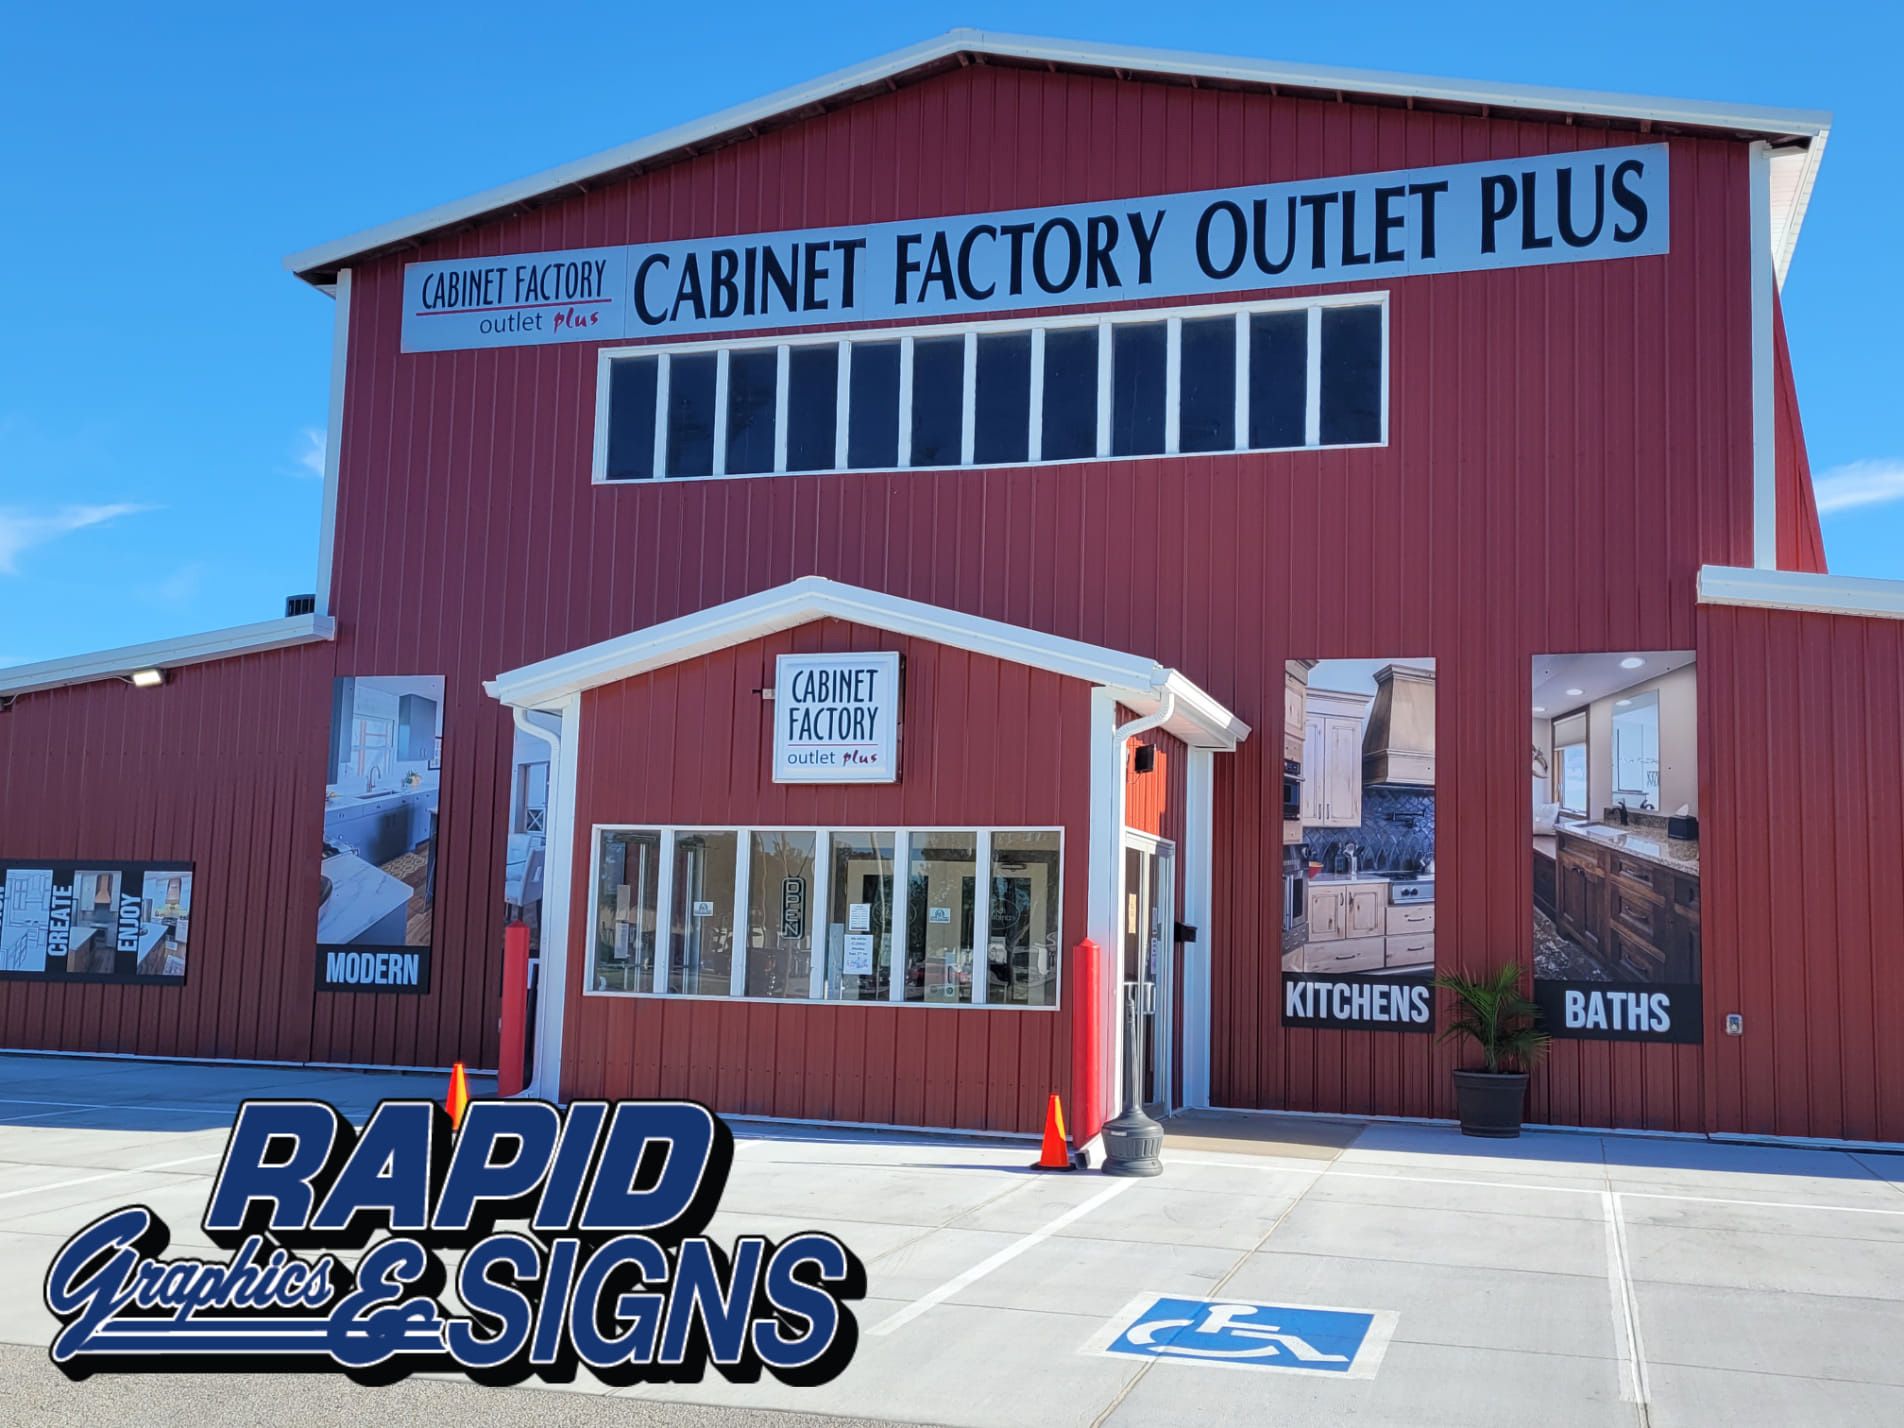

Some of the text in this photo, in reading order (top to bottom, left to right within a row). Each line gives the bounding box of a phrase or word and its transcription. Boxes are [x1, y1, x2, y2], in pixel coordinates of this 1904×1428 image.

[634, 159, 1649, 326] CABINET FACTORY OUTLET PLUS
[422, 259, 607, 310] CABINET FACTORY
[479, 307, 599, 334] outlet plus
[791, 668, 879, 704] CABINET
[788, 706, 879, 741] FACTORY
[787, 750, 878, 767] outlet plus
[47, 885, 72, 956] CREATE
[117, 893, 141, 952] ENJOY
[784, 881, 801, 936] OPEN
[326, 952, 419, 986] MODERN
[1286, 981, 1430, 1024] KITCHENS
[1565, 990, 1671, 1033] BATHS
